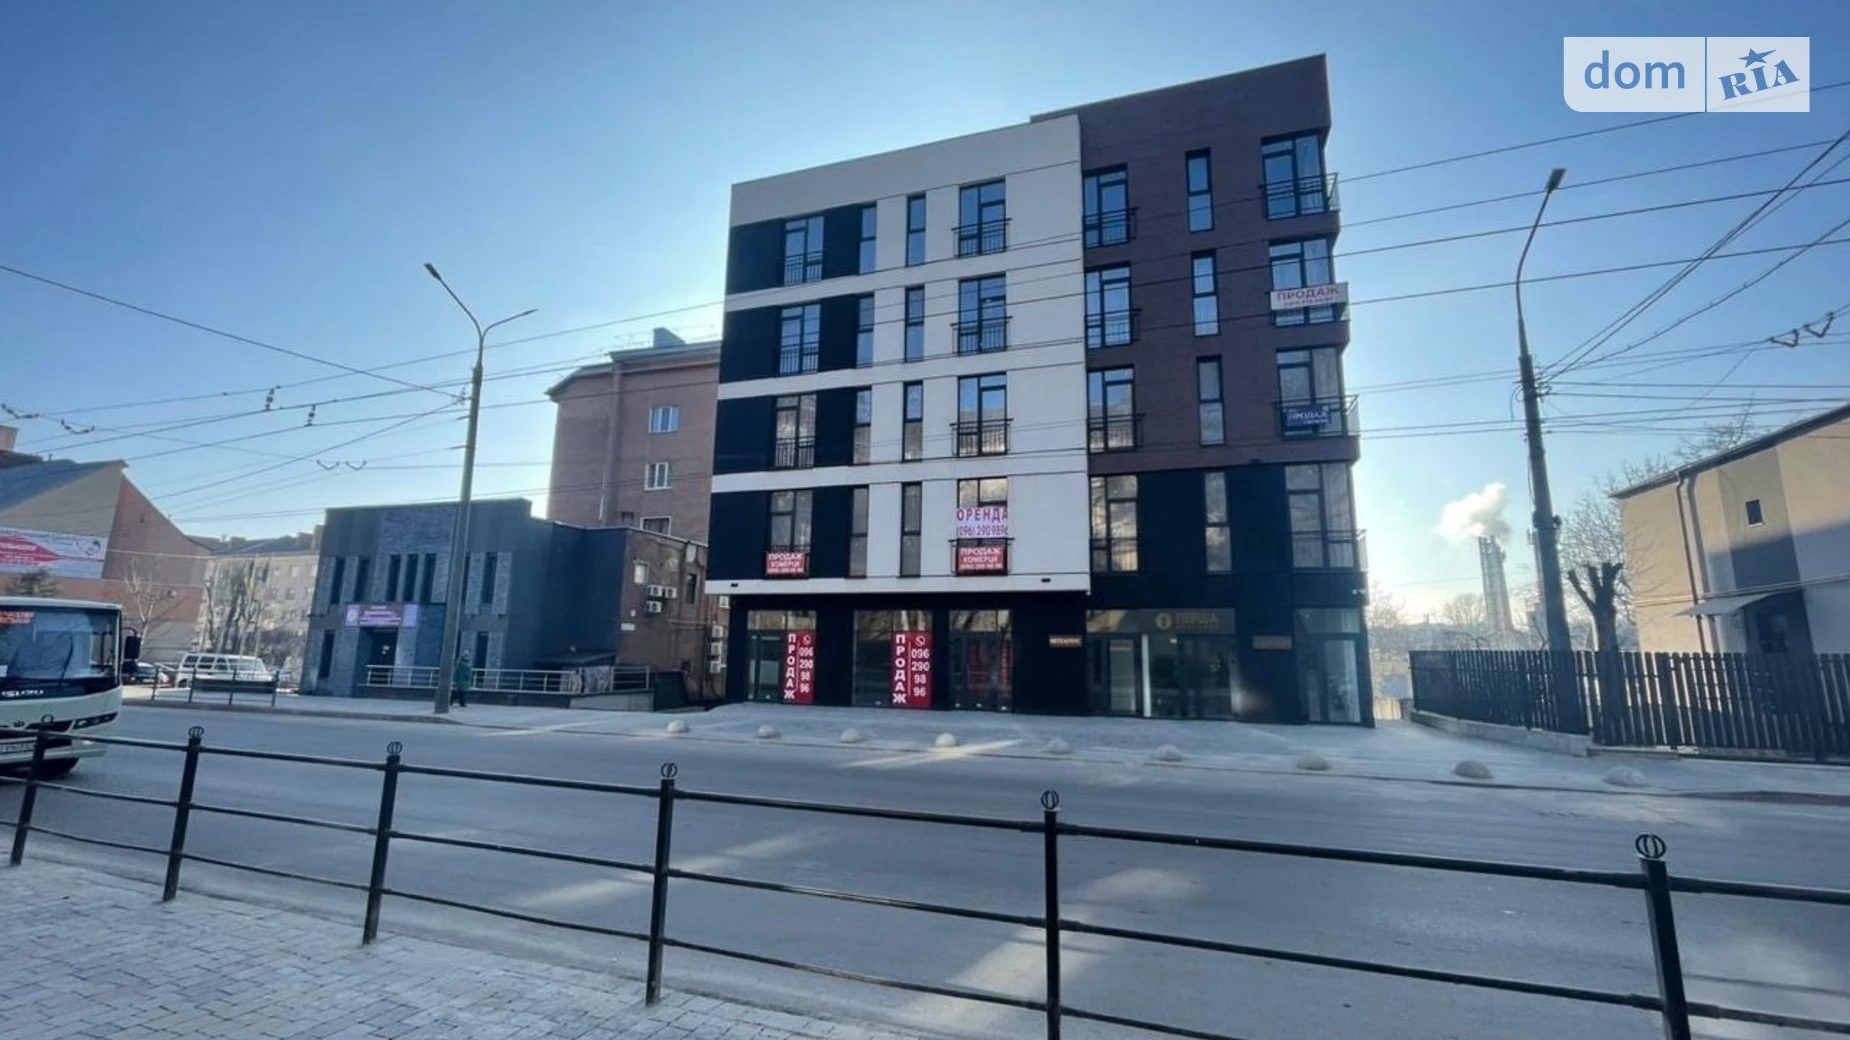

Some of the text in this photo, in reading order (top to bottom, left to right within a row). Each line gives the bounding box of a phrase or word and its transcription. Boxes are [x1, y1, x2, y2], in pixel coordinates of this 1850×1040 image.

[1277, 285, 1339, 301] ПРОДАЖ
[957, 508, 1008, 523] ОРЕНДА
[768, 552, 804, 561] ПРОДАЖ
[960, 547, 1001, 556] ПРОДАЖ
[800, 647, 814, 657] 096
[911, 648, 930, 659] 096
[784, 633, 796, 699] ПРОДАЖ
[799, 659, 814, 669] 290
[892, 634, 907, 704] ПРОДАЖ
[911, 661, 930, 672] 290
[800, 671, 811, 681] 98
[913, 673, 927, 684] 98
[799, 683, 810, 693] 96
[913, 686, 926, 697] 96
